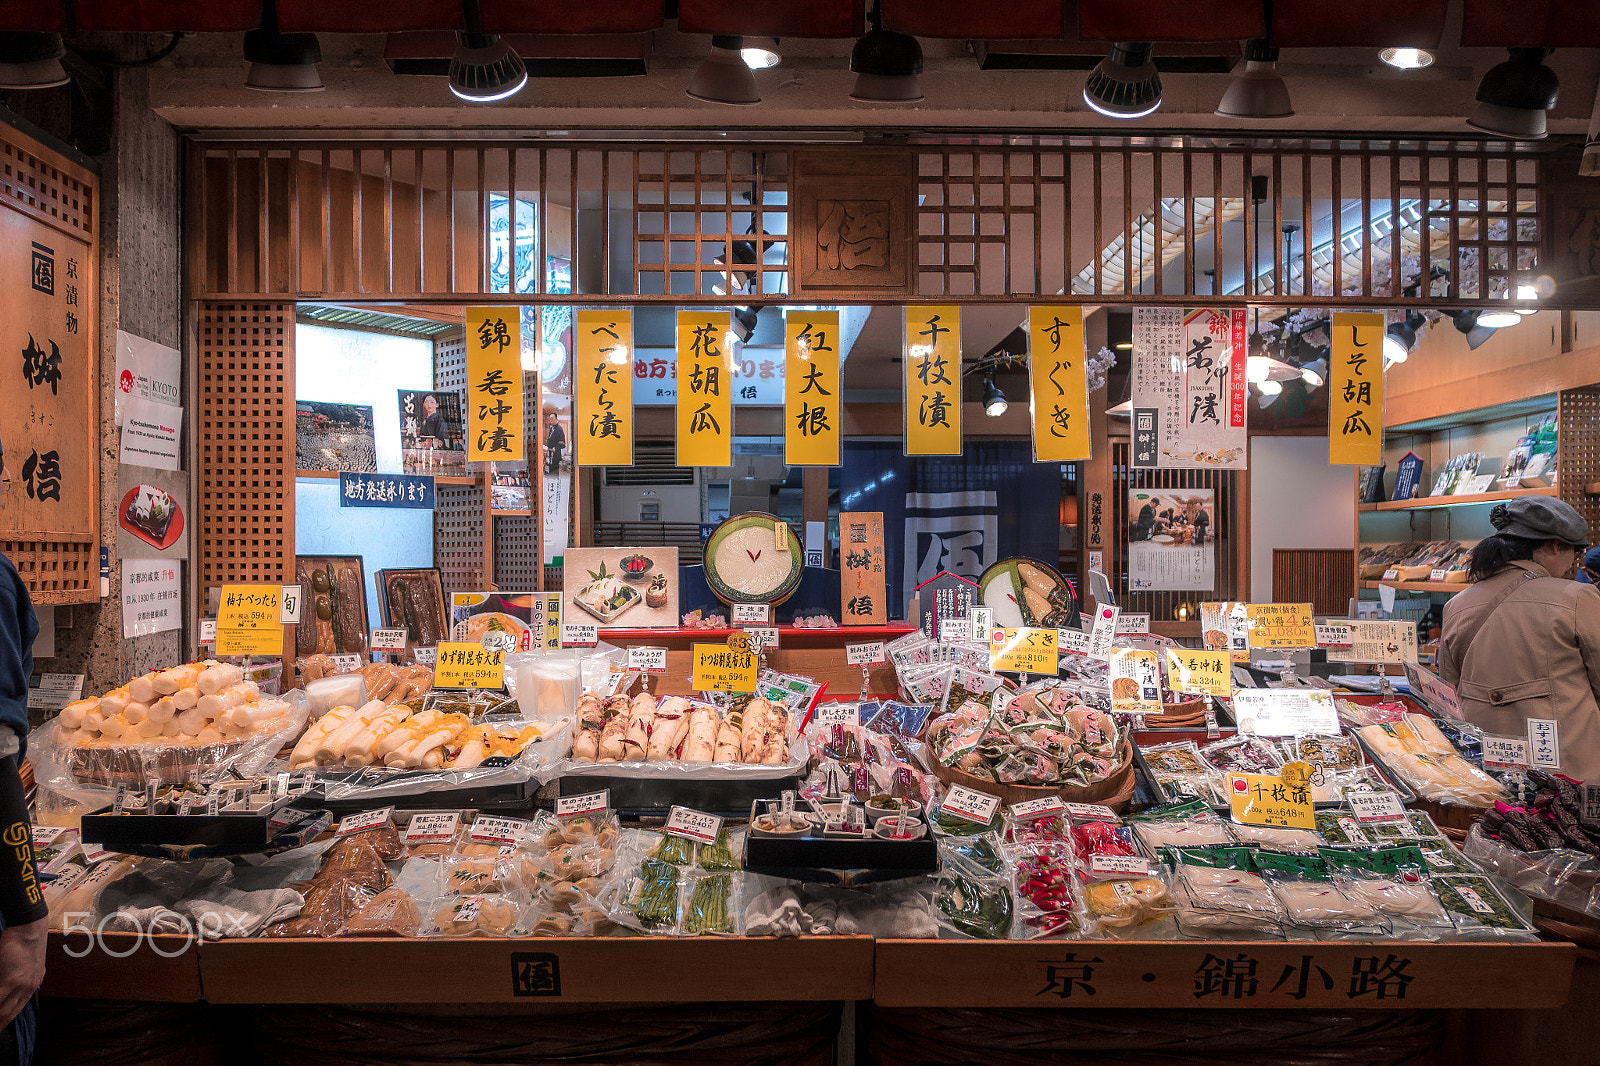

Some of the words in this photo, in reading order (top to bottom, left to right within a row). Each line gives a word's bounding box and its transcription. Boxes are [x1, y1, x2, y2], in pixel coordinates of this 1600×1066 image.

[66, 257, 78, 335] 京漬物
[152, 380, 178, 397] KYOTO
[589, 321, 622, 439] べったら漬
[689, 322, 722, 435] 花胡瓜
[796, 322, 833, 437] 紅大根
[916, 314, 952, 429] 千枚漬
[1041, 316, 1071, 438] すぐき
[1342, 325, 1372, 436] しそ胡瓜
[344, 480, 427, 502] 地方発送承ります
[284, 594, 297, 615] 旬
[976, 611, 987, 639] 新漬
[1251, 780, 1311, 805] 千枚漬
[1035, 952, 1415, 1000] 京・錦小路
